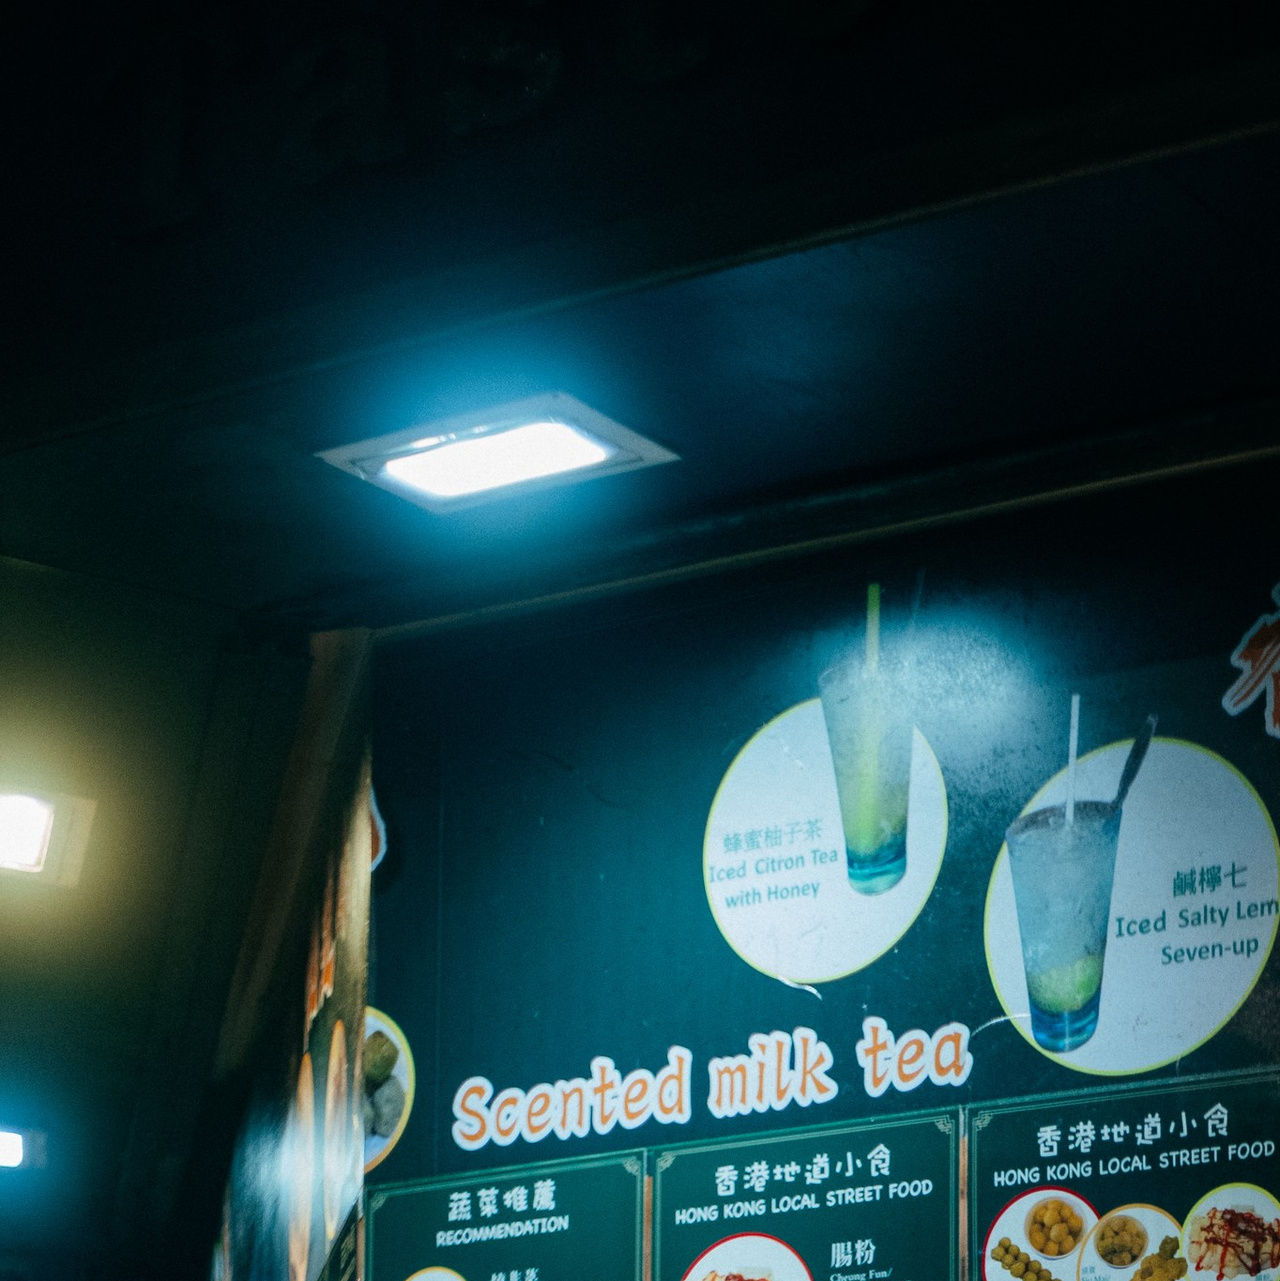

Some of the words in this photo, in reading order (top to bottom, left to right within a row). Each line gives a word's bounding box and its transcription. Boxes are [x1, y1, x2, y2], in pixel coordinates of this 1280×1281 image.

[723, 817, 824, 854] 蜂蜜柚子茶
[708, 861, 747, 883] Iced
[754, 854, 805, 875] Citron
[811, 848, 838, 865] Tea
[1173, 861, 1248, 897] 鹹檸七
[725, 888, 762, 908] with
[767, 881, 820, 900] Honey
[1115, 909, 1167, 938] Iced
[1178, 904, 1229, 928] Salty
[1161, 936, 1259, 966] Seven-up
[451, 1045, 694, 1152] Scented
[706, 1026, 839, 1119] milk
[855, 1015, 974, 1098] tea
[1037, 1102, 1229, 1157] 香港地道小食
[715, 1142, 891, 1197] 香港地道小食
[993, 1166, 1040, 1188] HONG
[1046, 1159, 1092, 1182] KONG
[1099, 1154, 1151, 1176] LOCAL
[1159, 1146, 1221, 1169] STREET
[1227, 1140, 1275, 1161] FOOD
[675, 1205, 719, 1225] HONG
[723, 1199, 767, 1219] KONG
[771, 1193, 820, 1213] LOCAL
[826, 1185, 882, 1207] STREET
[888, 1179, 933, 1199] FOOD
[435, 1215, 570, 1248] RECOMMENDATION
[830, 1239, 876, 1268] 腸粉
[869, 1267, 894, 1280] Fun/
